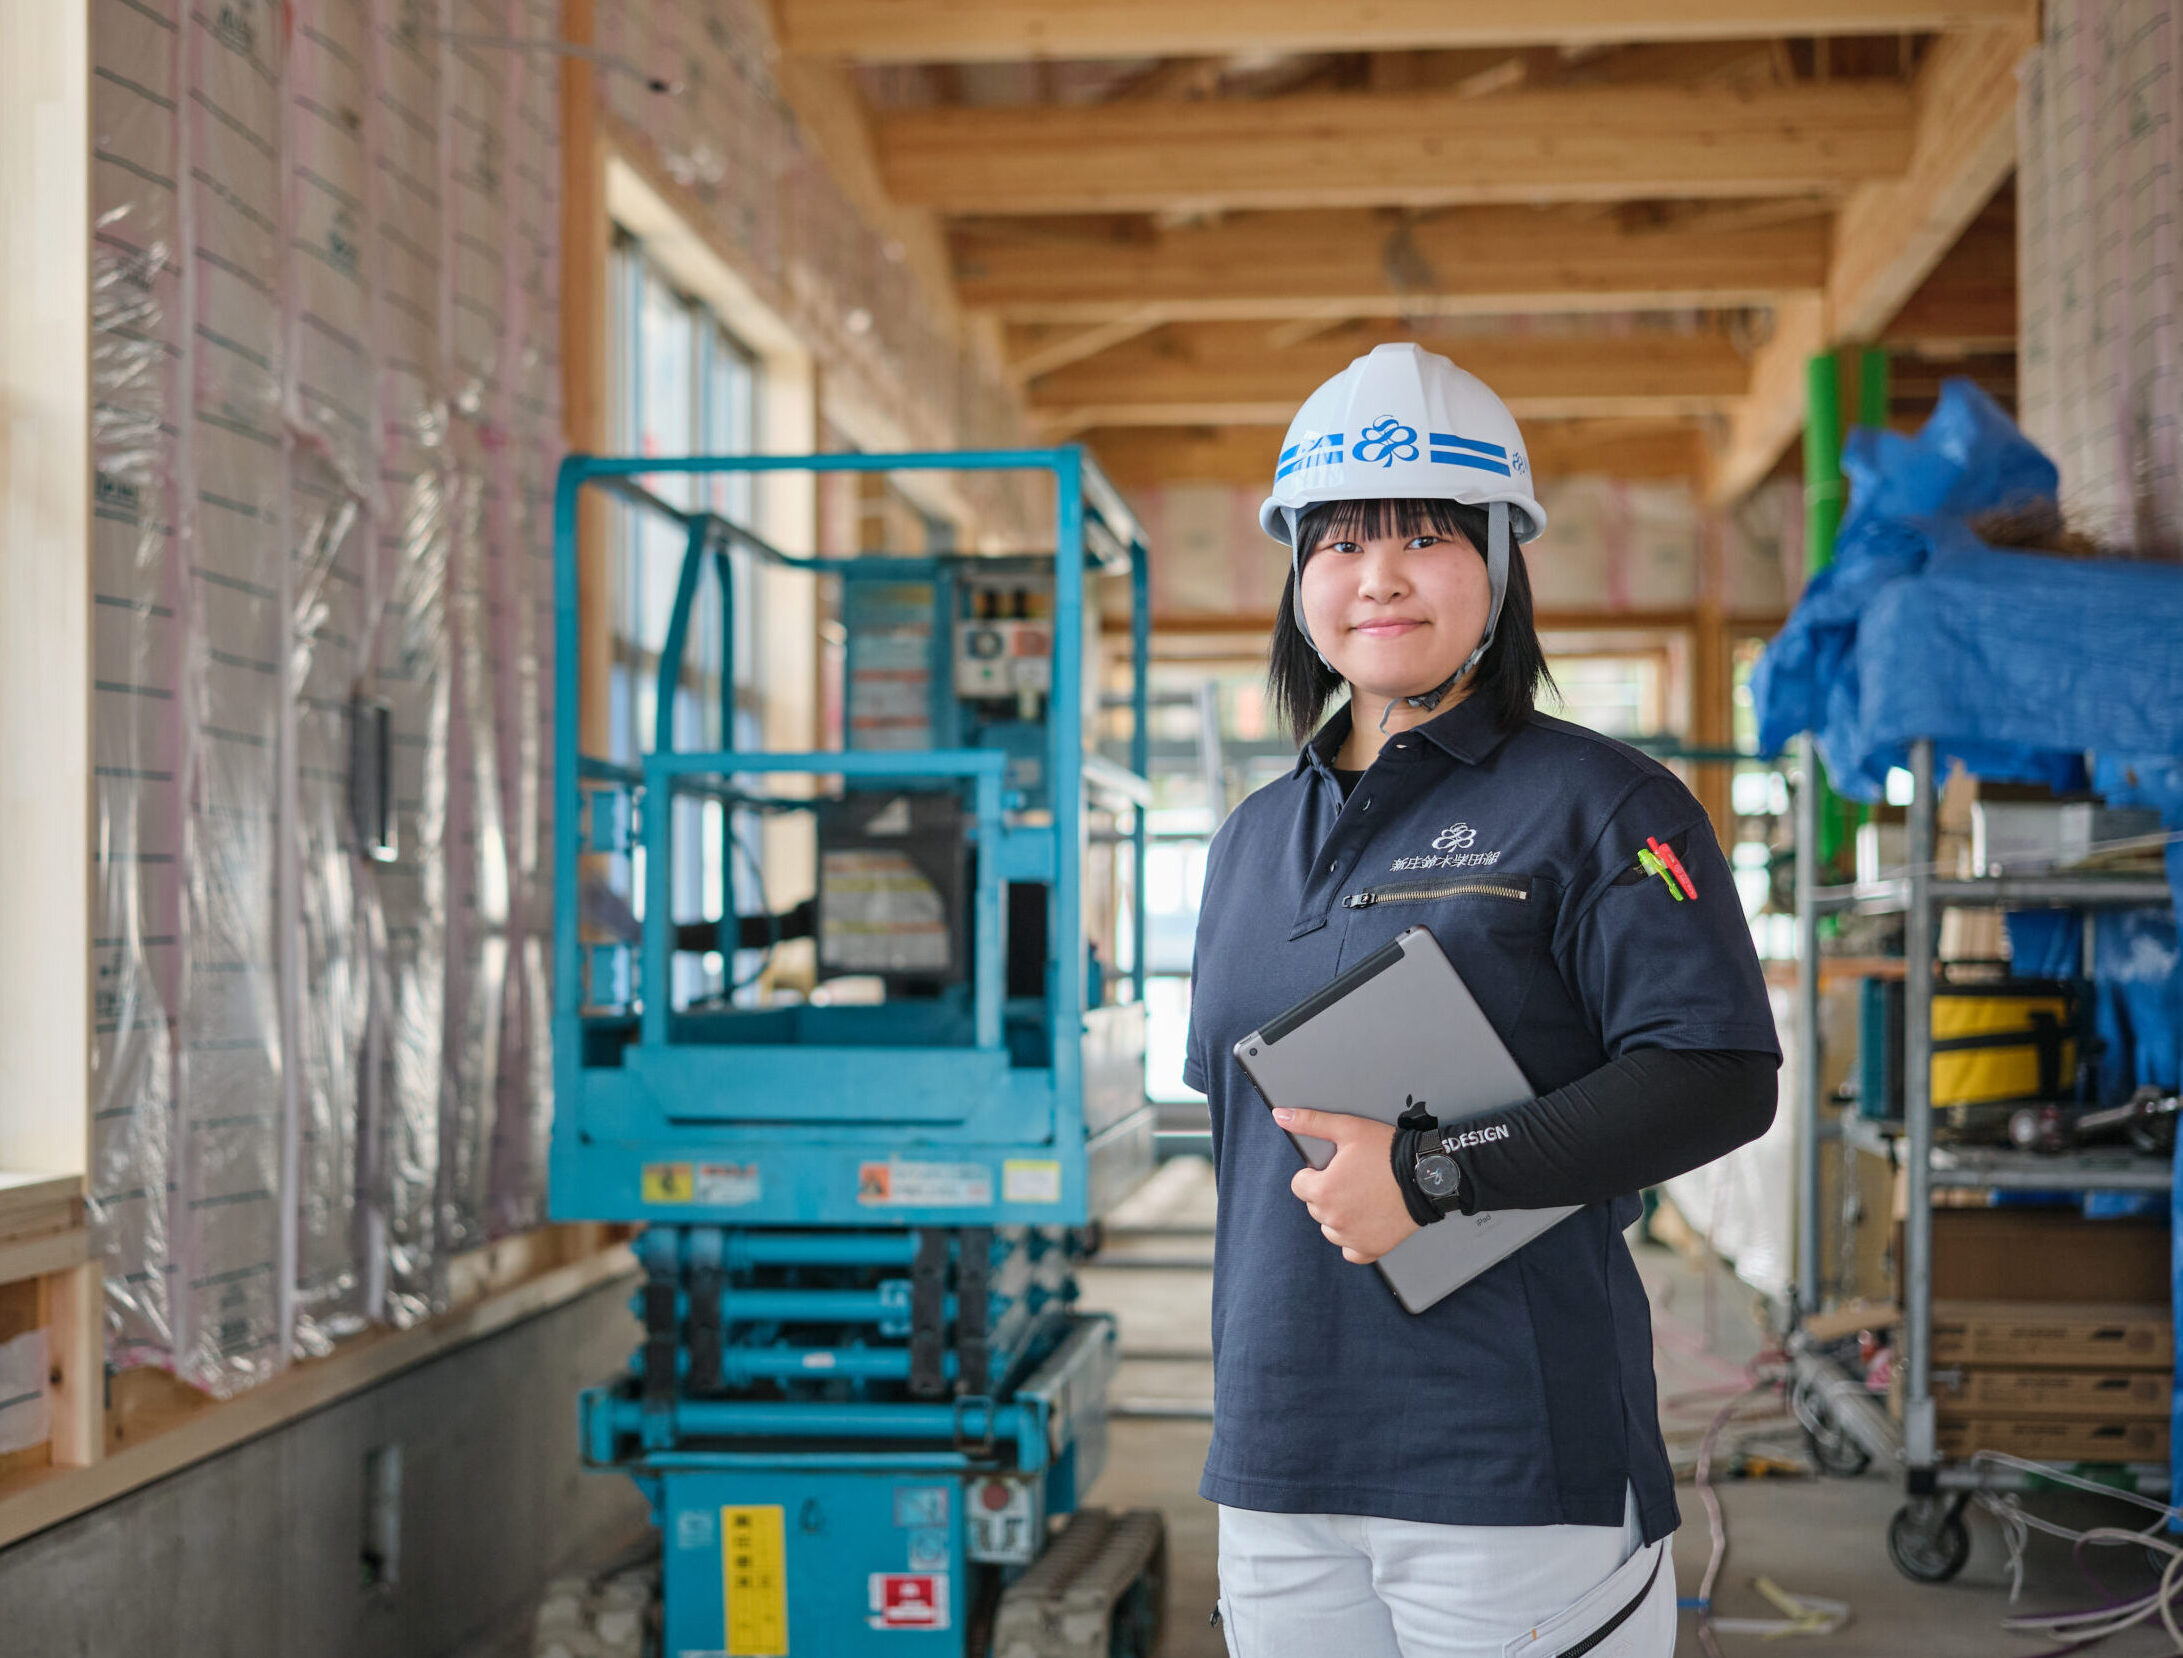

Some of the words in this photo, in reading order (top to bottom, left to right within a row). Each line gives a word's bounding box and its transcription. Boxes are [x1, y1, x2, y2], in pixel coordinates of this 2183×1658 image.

[1389, 851, 1501, 872] 新庄鈴木柴田組
[1475, 1214, 1492, 1227] iPad
